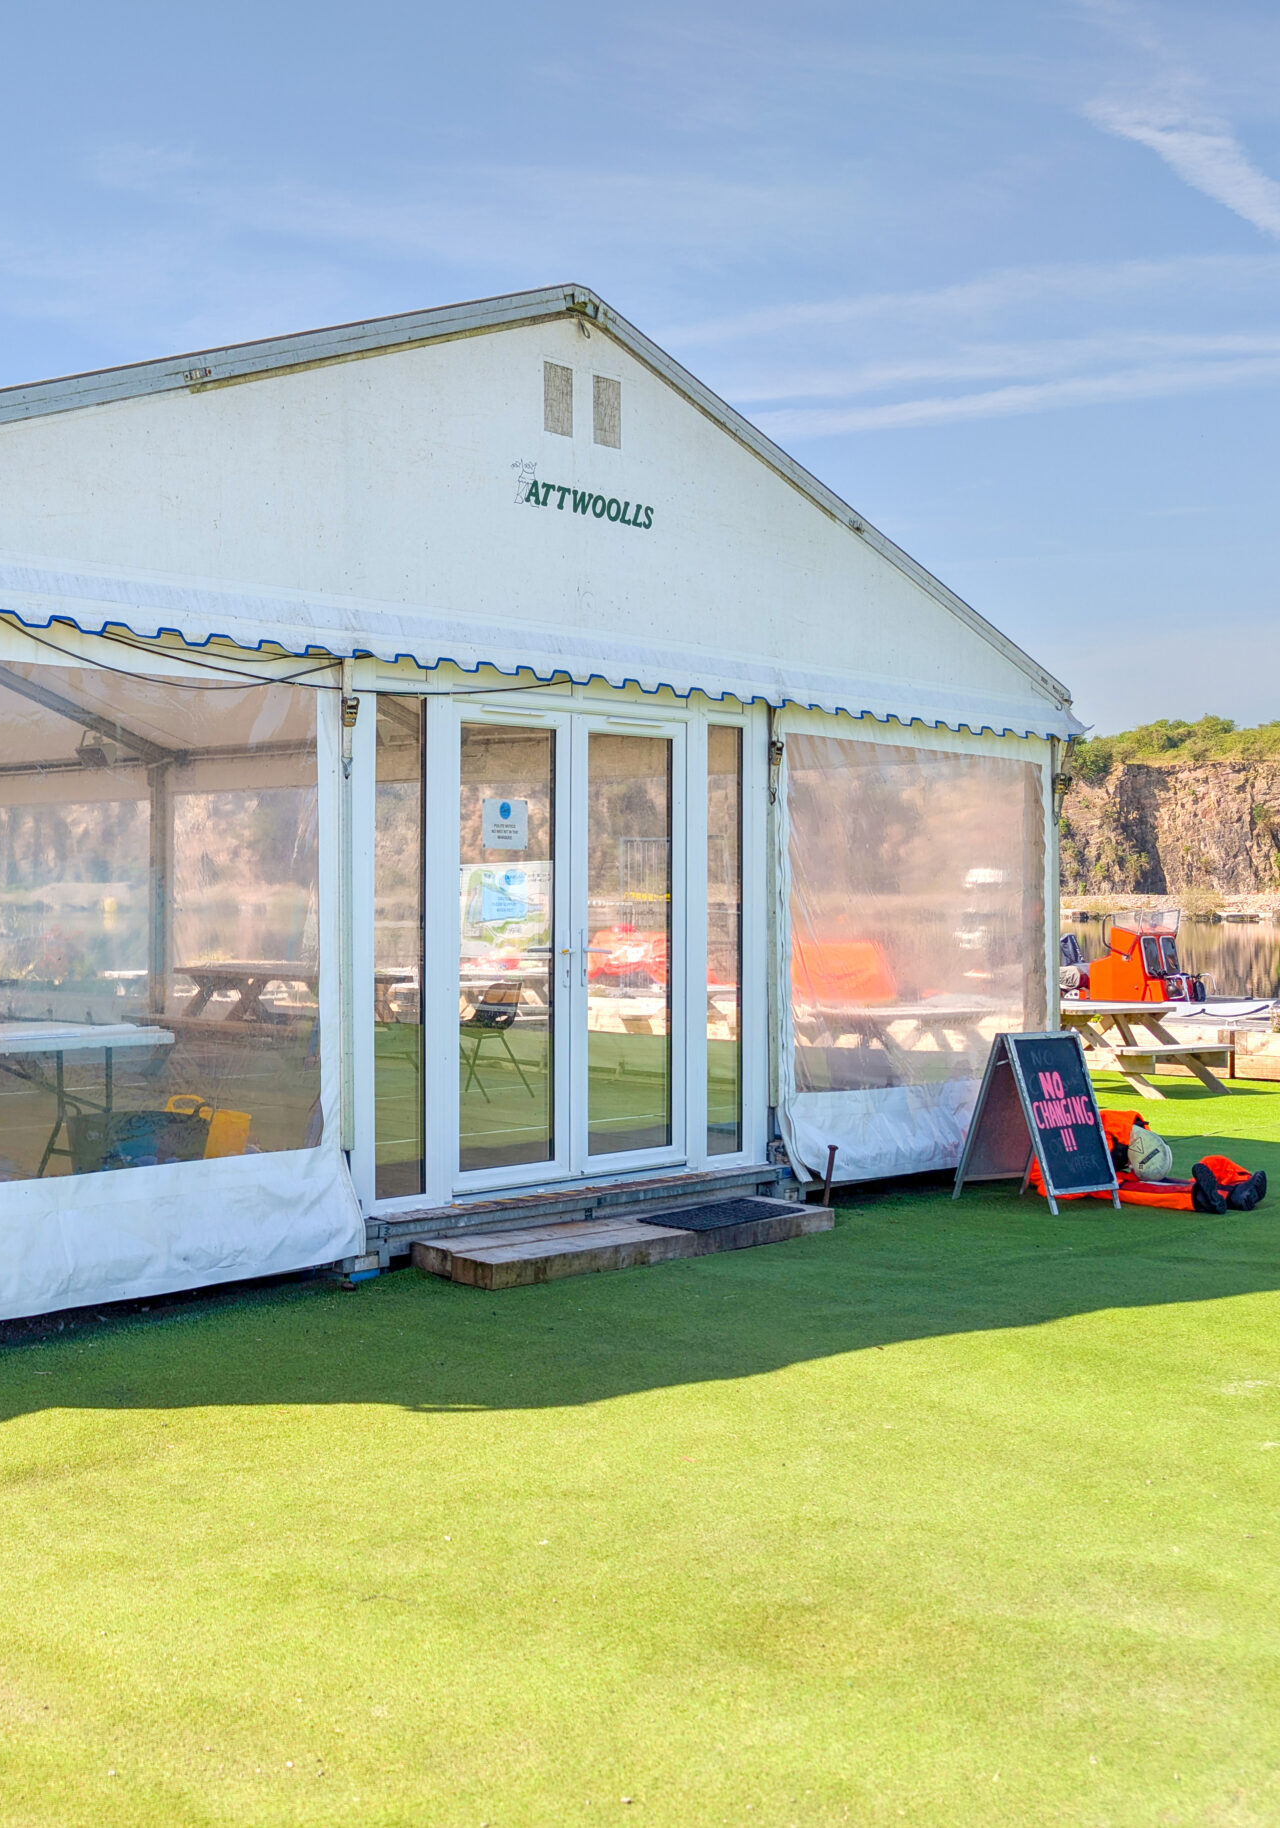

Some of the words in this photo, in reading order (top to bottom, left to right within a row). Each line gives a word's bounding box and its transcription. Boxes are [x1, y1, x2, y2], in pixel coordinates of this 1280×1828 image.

[525, 479, 654, 529] ATTWOOLLS
[1038, 1071, 1065, 1099] NO
[1032, 1095, 1095, 1130] CHANGING
